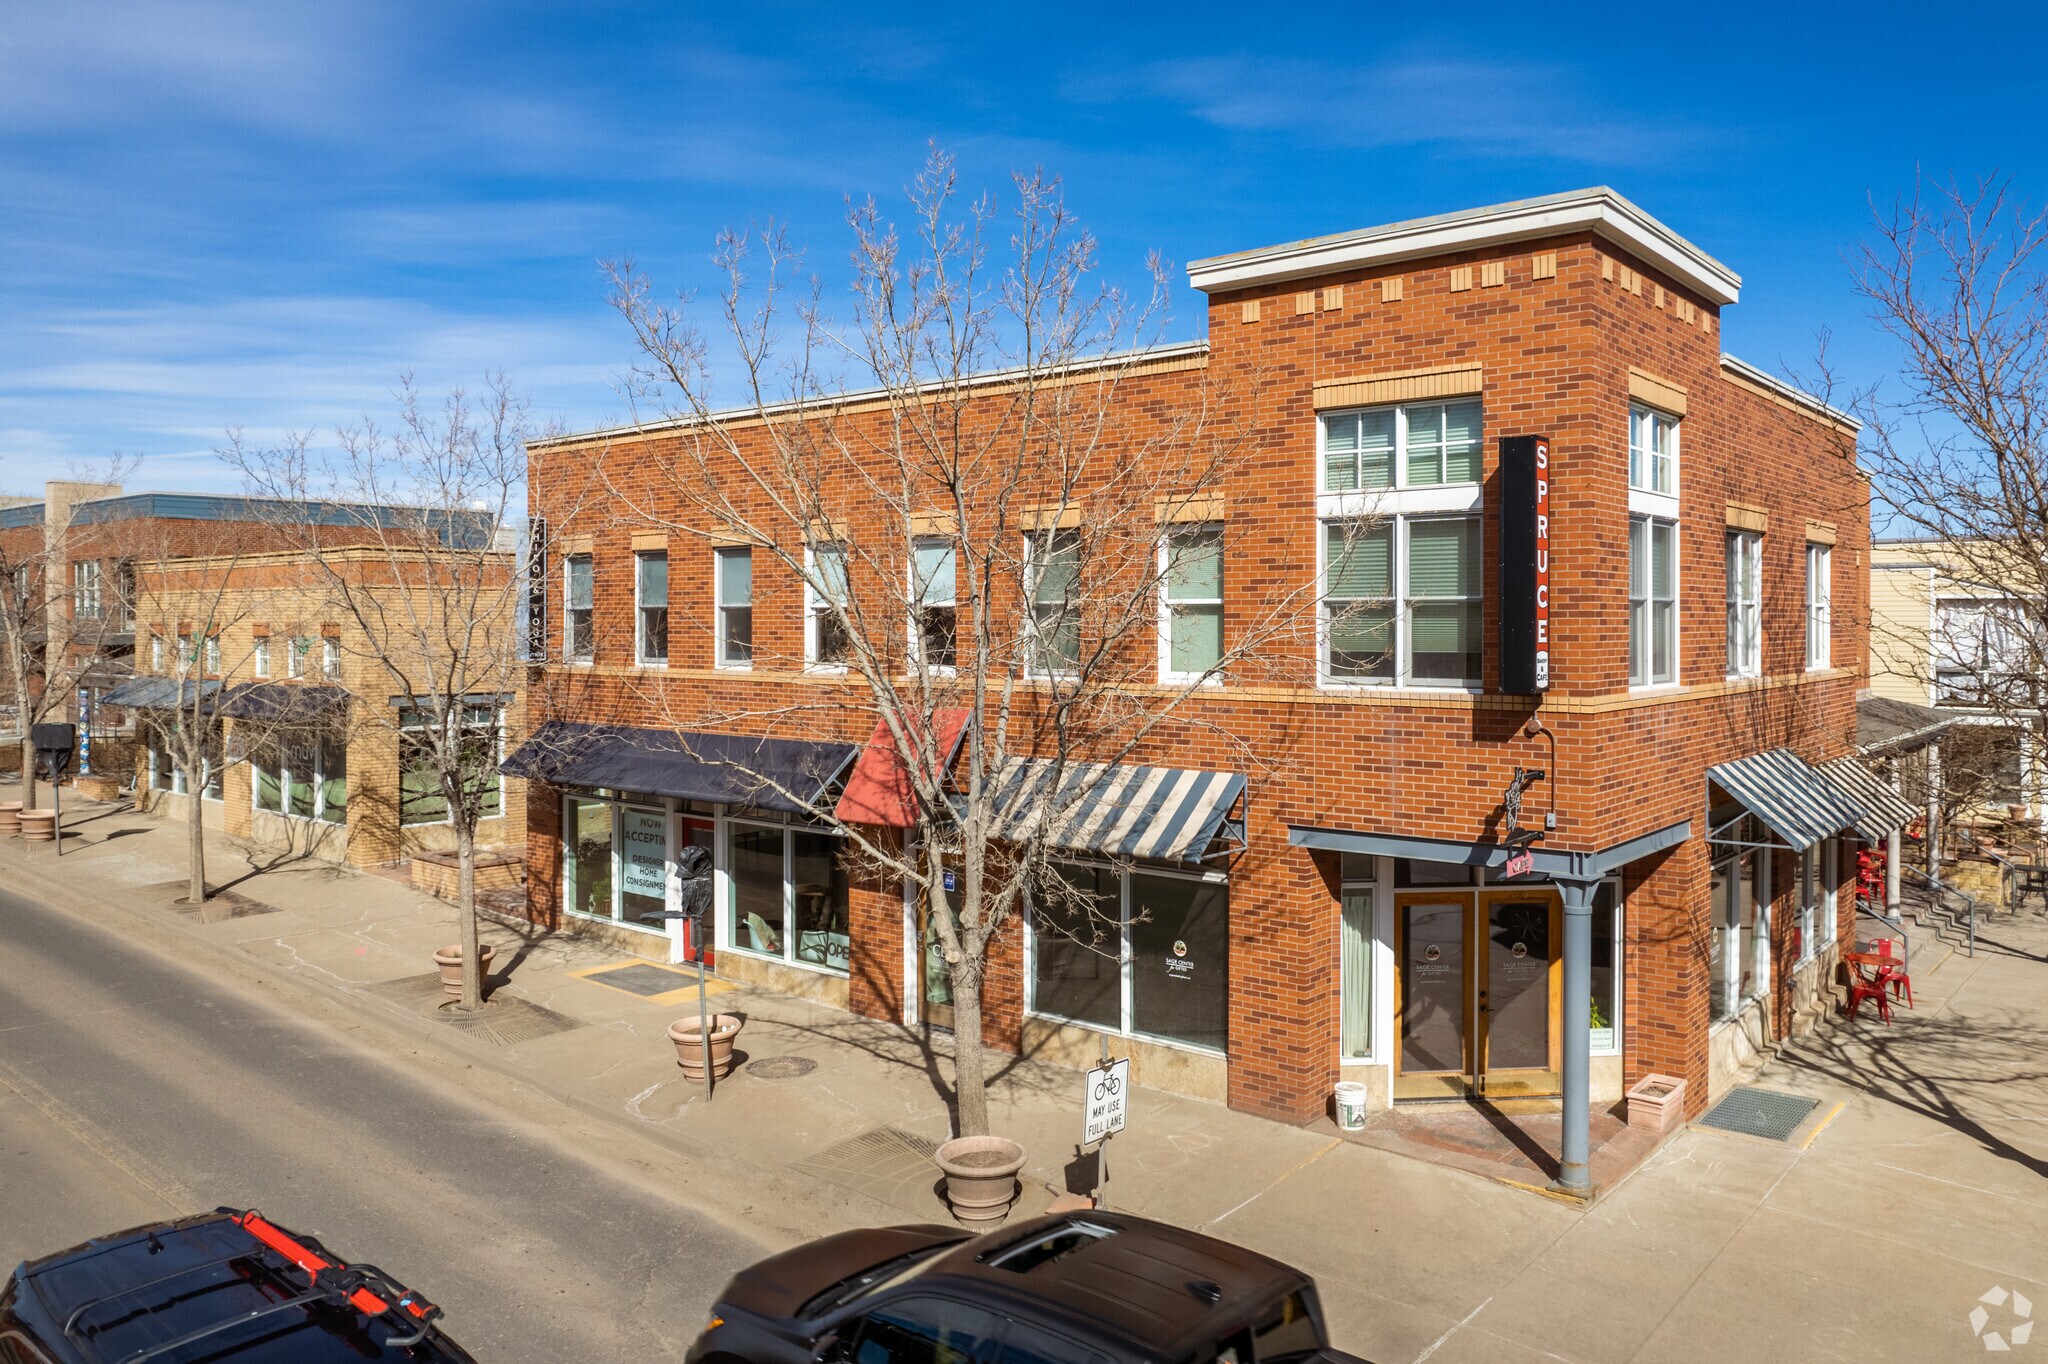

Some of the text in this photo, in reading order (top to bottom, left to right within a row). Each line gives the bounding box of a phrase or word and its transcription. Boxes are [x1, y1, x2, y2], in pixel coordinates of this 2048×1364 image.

[532, 522, 540, 573] HIRO
[1536, 445, 1548, 643] SPRUCE
[532, 607, 540, 647] YOGA
[640, 817, 662, 829] NOW
[632, 854, 664, 867] DESIGNER
[640, 867, 657, 878] HOME
[1165, 957, 1177, 965] SAGE
[1092, 1099, 1120, 1119] MAY USE
[1088, 1113, 1123, 1137] FULL LANE
